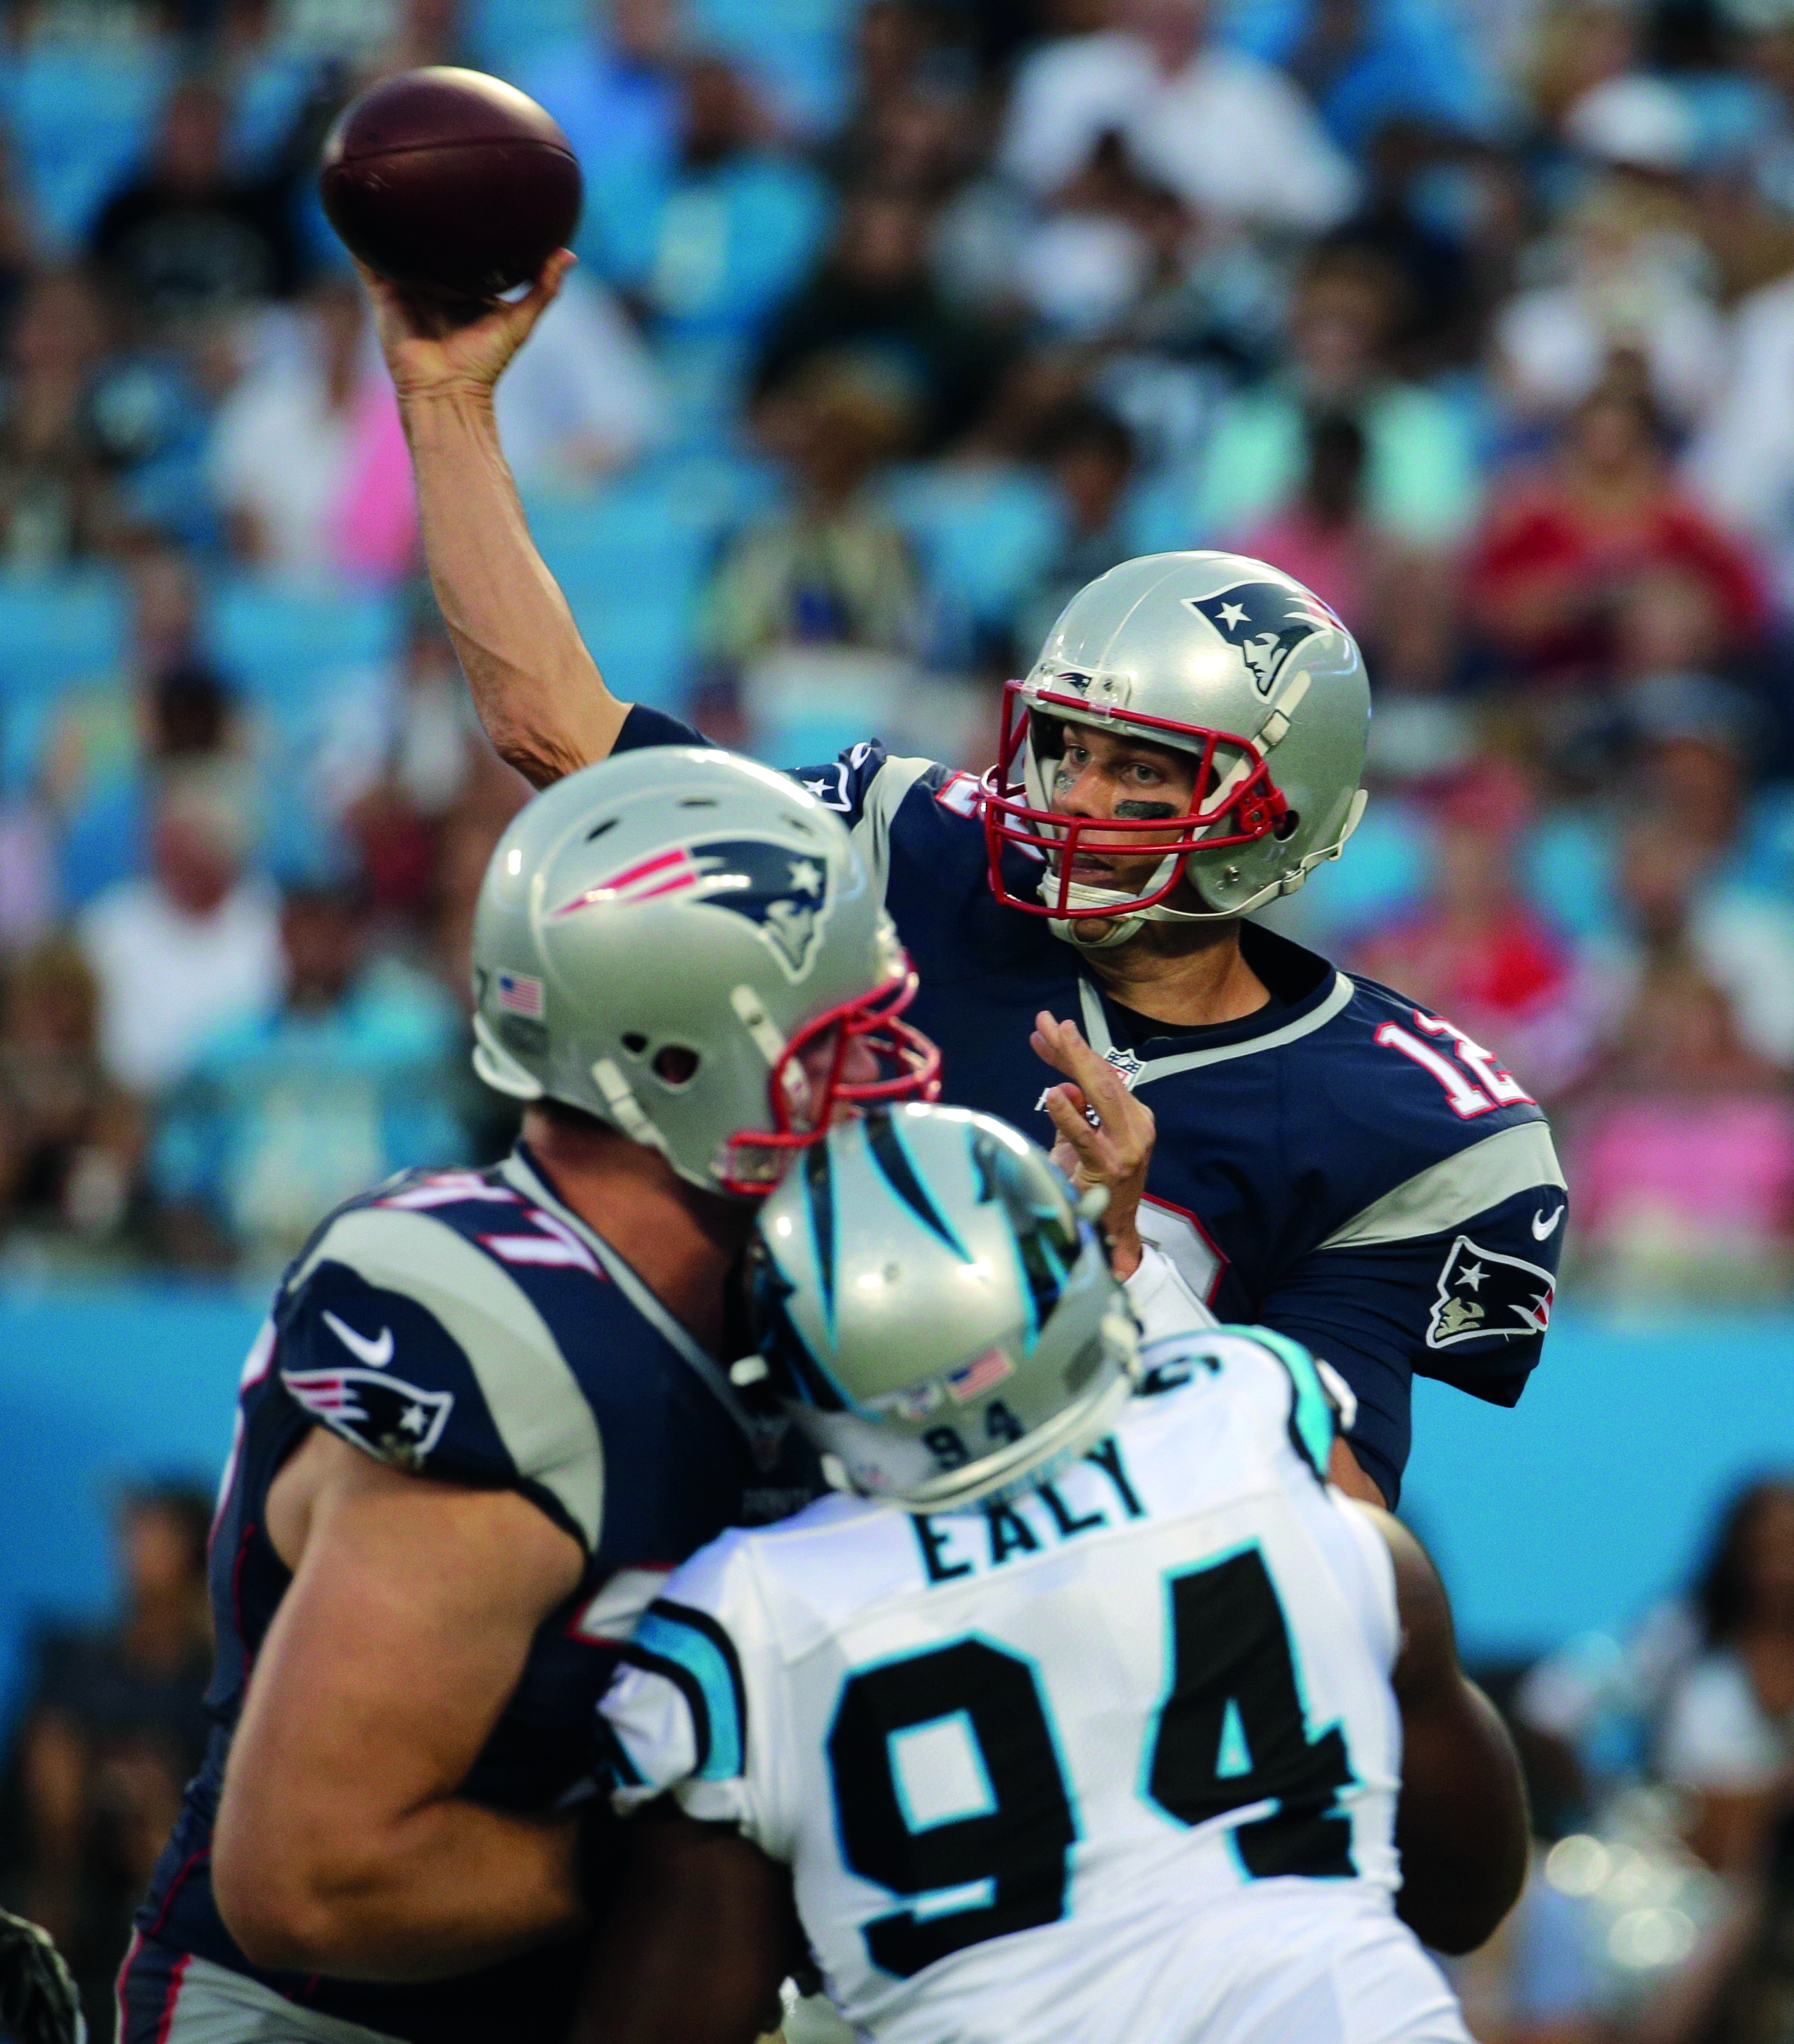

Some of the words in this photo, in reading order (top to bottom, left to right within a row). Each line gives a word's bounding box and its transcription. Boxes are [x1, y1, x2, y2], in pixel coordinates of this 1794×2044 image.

[1373, 1009, 1537, 1120] 12
[921, 1397, 1024, 1470] 94
[908, 1431, 1148, 1588] EALY
[821, 1535, 1366, 1984] 94
